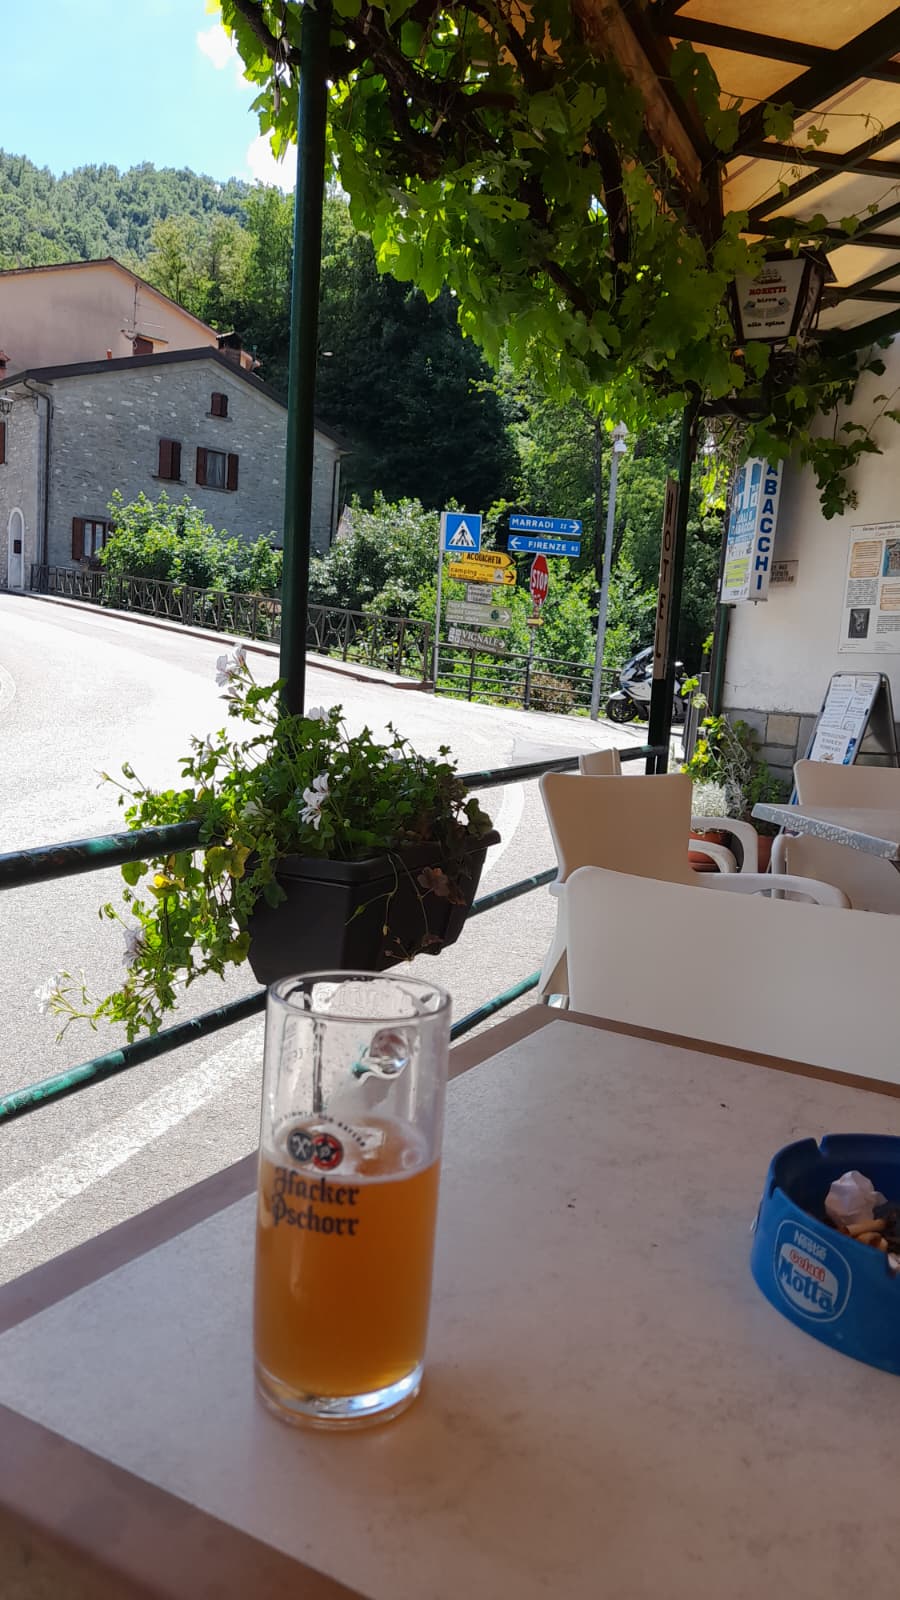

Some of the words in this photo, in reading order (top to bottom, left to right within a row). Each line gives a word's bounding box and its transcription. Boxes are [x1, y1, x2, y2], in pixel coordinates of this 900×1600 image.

[511, 518, 554, 529] MARRADI
[755, 463, 778, 590] ABACCHI
[528, 541, 567, 552] FIRENZE
[531, 569, 547, 592] STOP
[274, 1166, 360, 1205] Hacker
[271, 1192, 360, 1236] Pschorr
[779, 1255, 834, 1313] Motta
